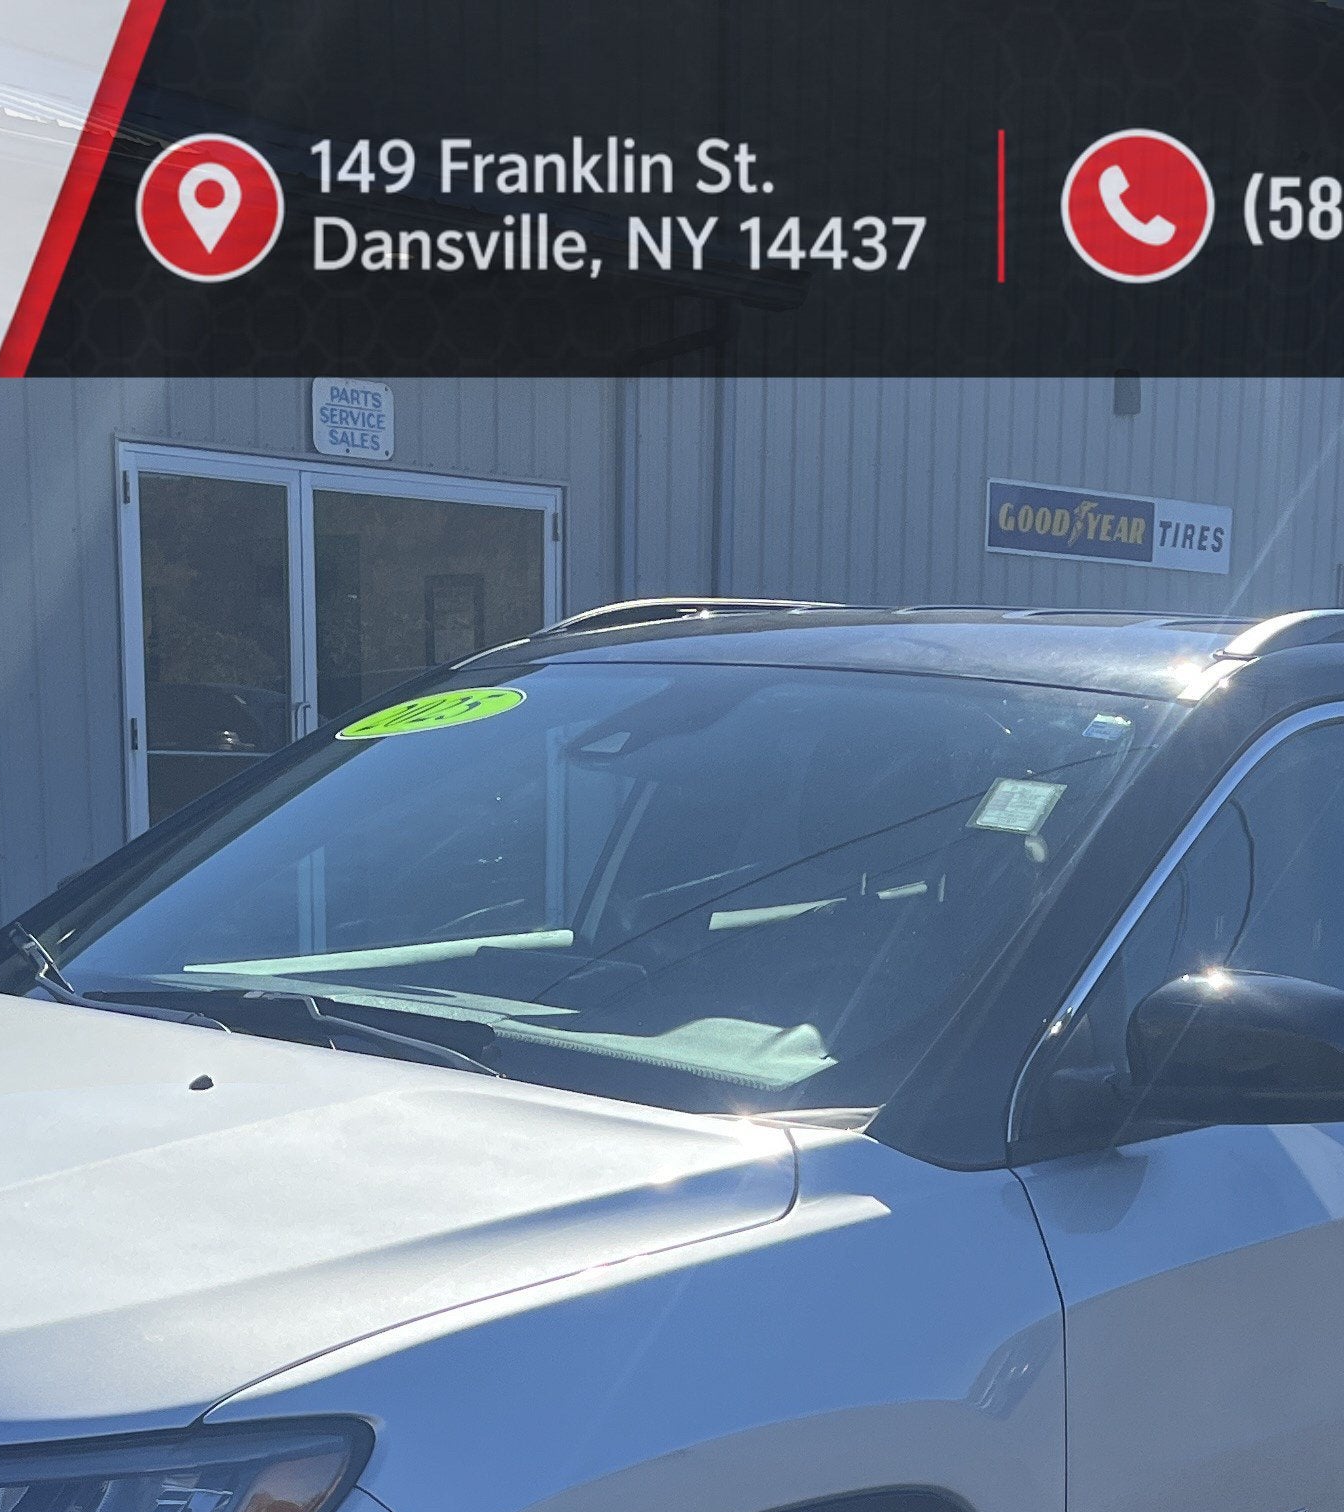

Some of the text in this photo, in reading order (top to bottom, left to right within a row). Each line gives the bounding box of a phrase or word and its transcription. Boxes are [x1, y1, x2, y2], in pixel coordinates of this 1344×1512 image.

[330, 386, 382, 409] PARTS
[320, 407, 386, 430] SERVICE
[328, 429, 381, 451] SALES
[1159, 520, 1225, 553] TIRES
